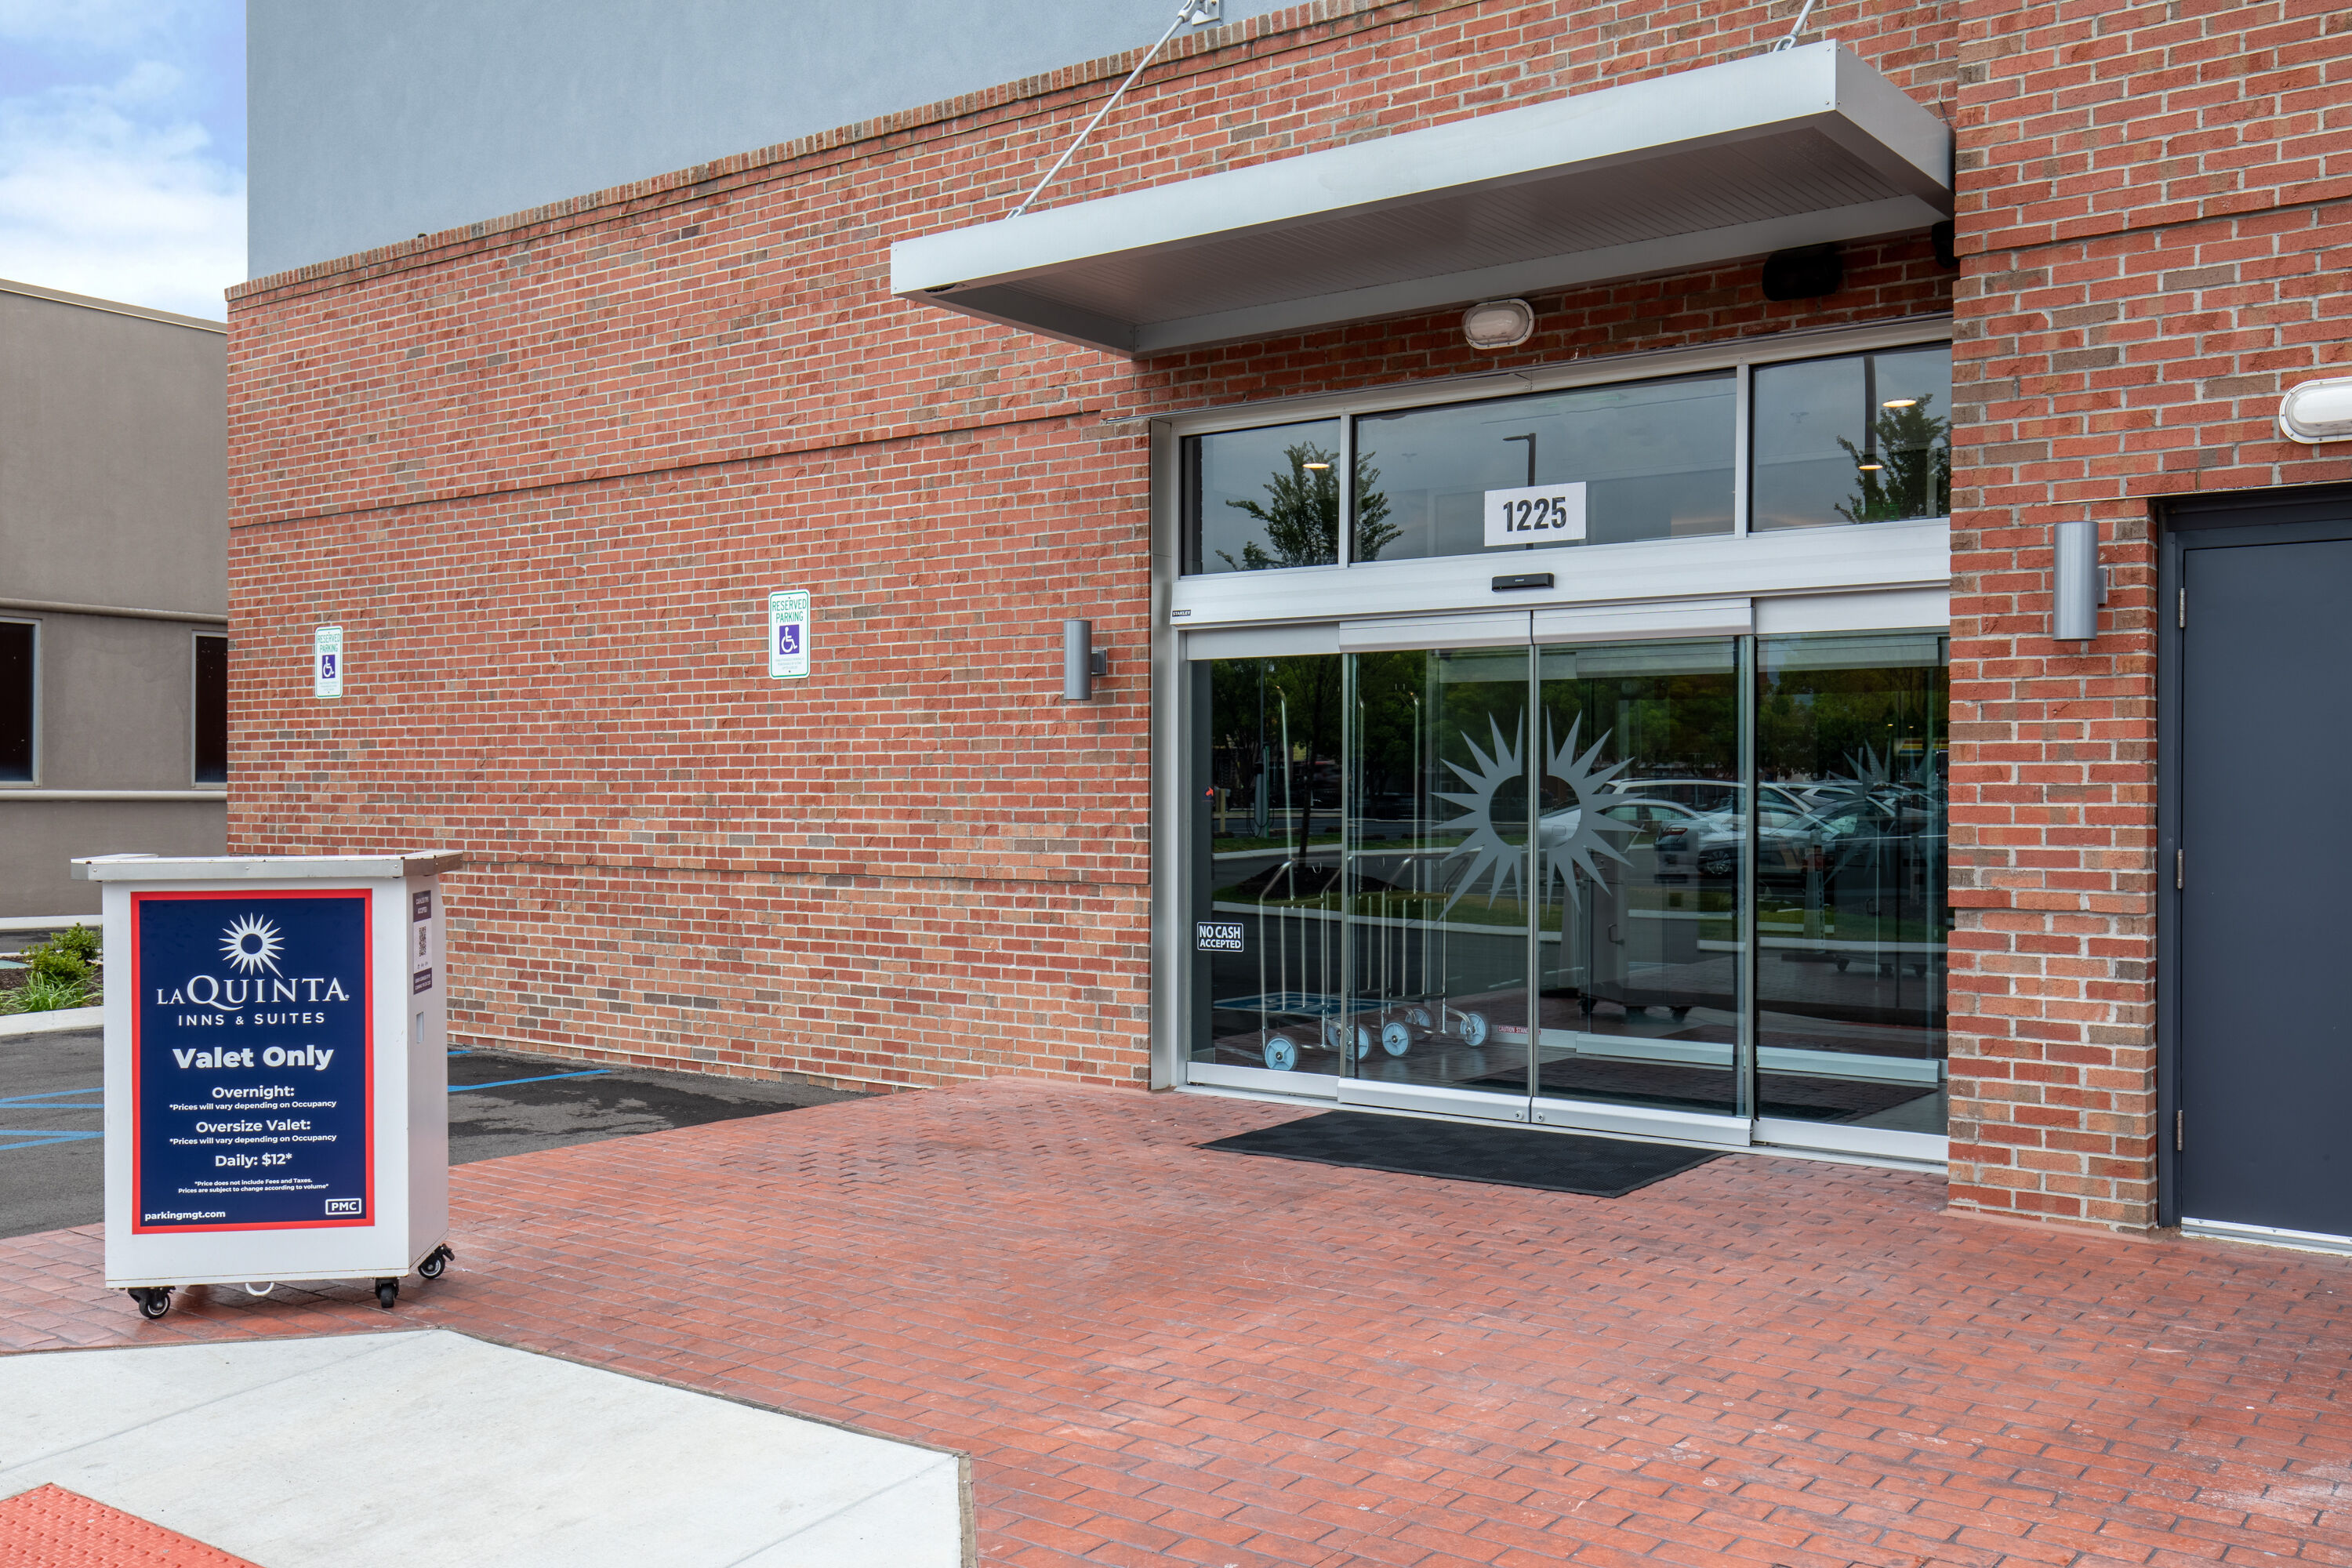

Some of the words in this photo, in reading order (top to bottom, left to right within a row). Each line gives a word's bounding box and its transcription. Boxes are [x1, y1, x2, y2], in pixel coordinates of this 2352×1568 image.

[1503, 496, 1567, 532] 1225
[771, 598, 807, 612] RESERVED
[775, 612, 804, 623] PARKING
[317, 633, 340, 643] RESERVED
[319, 644, 339, 653] PARKING
[1199, 925, 1214, 938] NO
[1215, 926, 1241, 939] CASH
[1200, 938, 1242, 949] ACCEPTED
[178, 1014, 225, 1026] INNS
[235, 1015, 245, 1025] &
[254, 1011, 325, 1025] SUITES
[172, 1046, 255, 1069] Valet
[262, 1044, 335, 1072] Only
[212, 1085, 296, 1100] Overnight:
[234, 1102, 278, 1111] depending
[196, 1120, 263, 1133] Oversize
[266, 1118, 311, 1131] Valet:
[234, 1135, 278, 1145] depending
[215, 1153, 259, 1168] Daily:
[144, 1210, 227, 1221] parkingmgt.com
[331, 1201, 358, 1211] PMC
